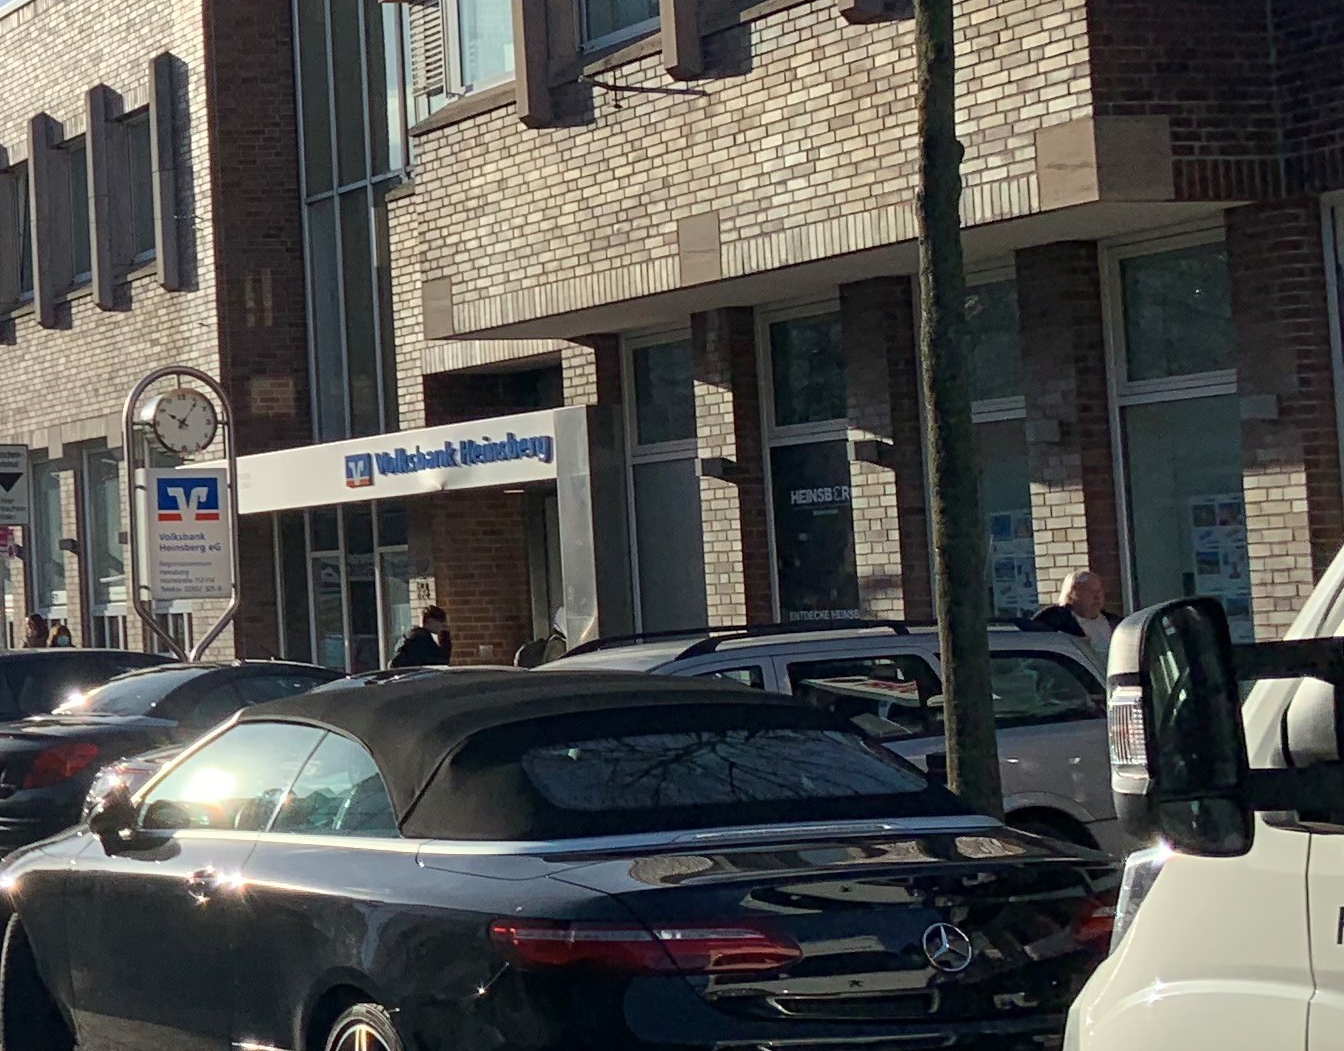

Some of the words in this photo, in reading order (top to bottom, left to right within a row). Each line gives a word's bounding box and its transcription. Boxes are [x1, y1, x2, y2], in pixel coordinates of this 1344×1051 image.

[374, 440, 462, 476] Volksbank
[459, 431, 554, 465] Heinsberg
[158, 532, 207, 541] Volksbank
[159, 543, 206, 554] Heinsberg
